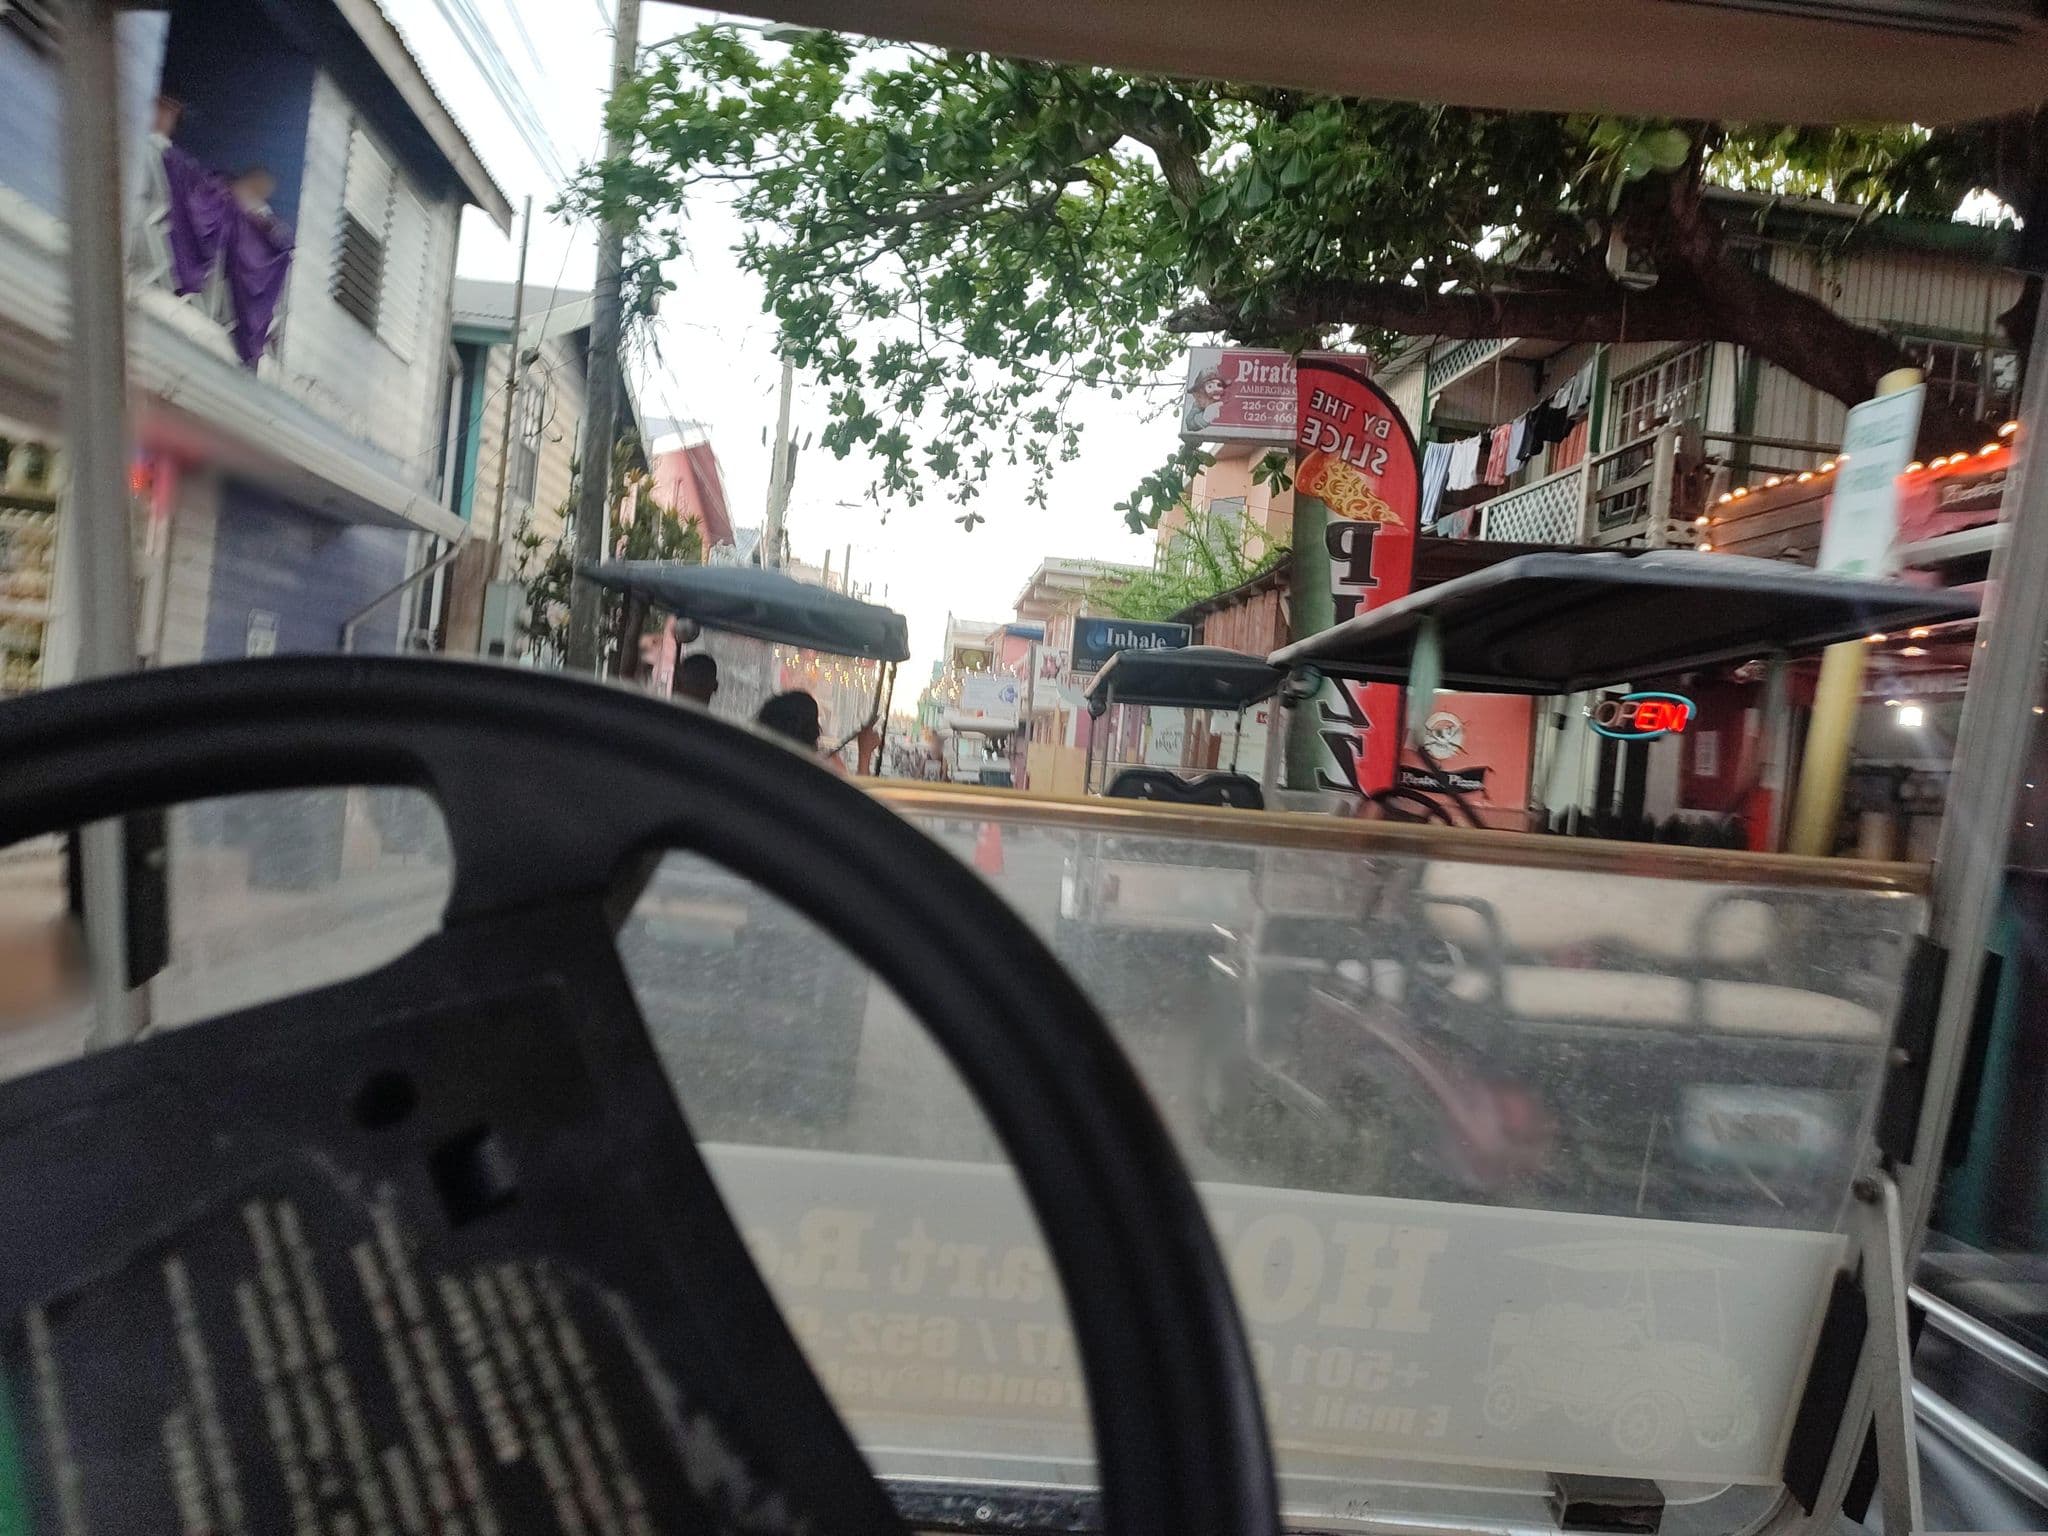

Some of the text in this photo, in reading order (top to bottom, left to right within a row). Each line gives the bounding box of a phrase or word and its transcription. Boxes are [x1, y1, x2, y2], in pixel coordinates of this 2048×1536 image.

[1240, 385, 1291, 395] AMBERGRIS
[1242, 401, 1297, 412] 226-GOO
[1106, 627, 1167, 650] Inhale
[1595, 701, 1690, 732] OPEN
